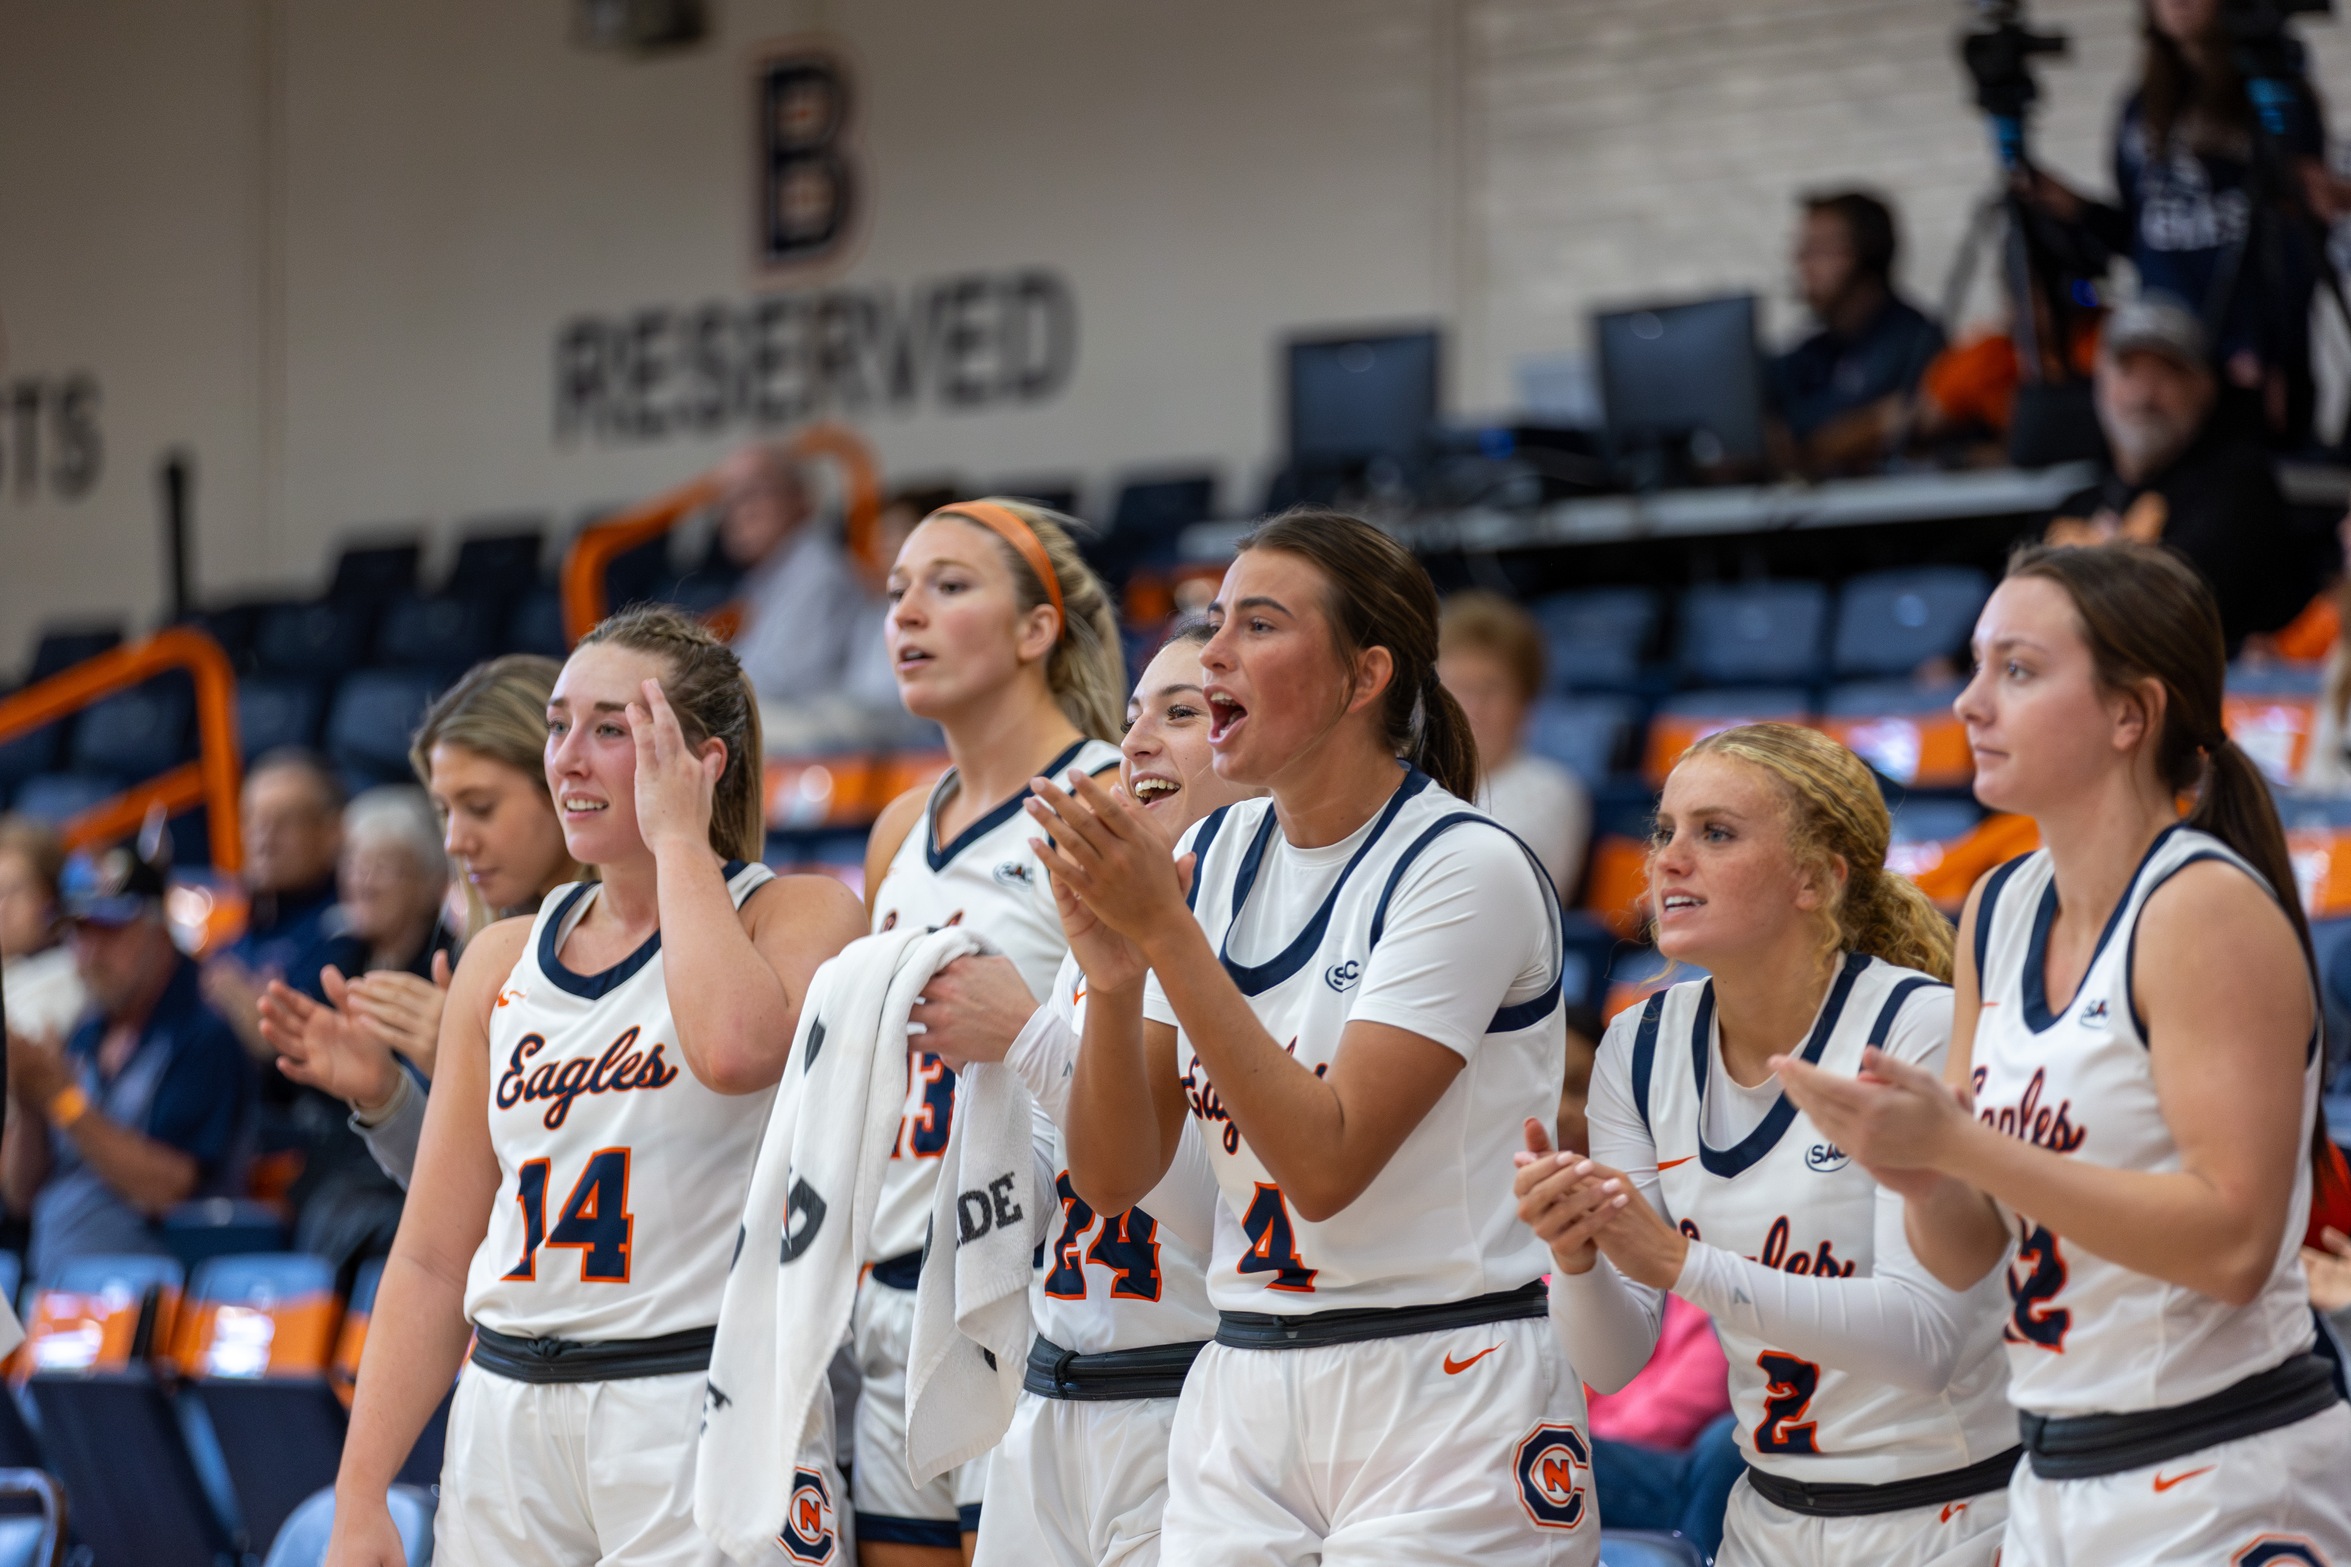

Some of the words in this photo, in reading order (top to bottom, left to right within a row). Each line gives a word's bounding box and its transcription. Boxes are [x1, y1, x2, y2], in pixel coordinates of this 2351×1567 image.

[755, 38, 862, 284] B
[553, 265, 1078, 452] RESERVED
[0, 372, 105, 503] TS
[496, 1025, 679, 1131] Eagles
[499, 1147, 634, 1284] 14
[956, 1171, 1023, 1252] DE
[1044, 1169, 1163, 1303] 24
[1236, 1180, 1319, 1293] 4
[1753, 1349, 1823, 1456] 2
